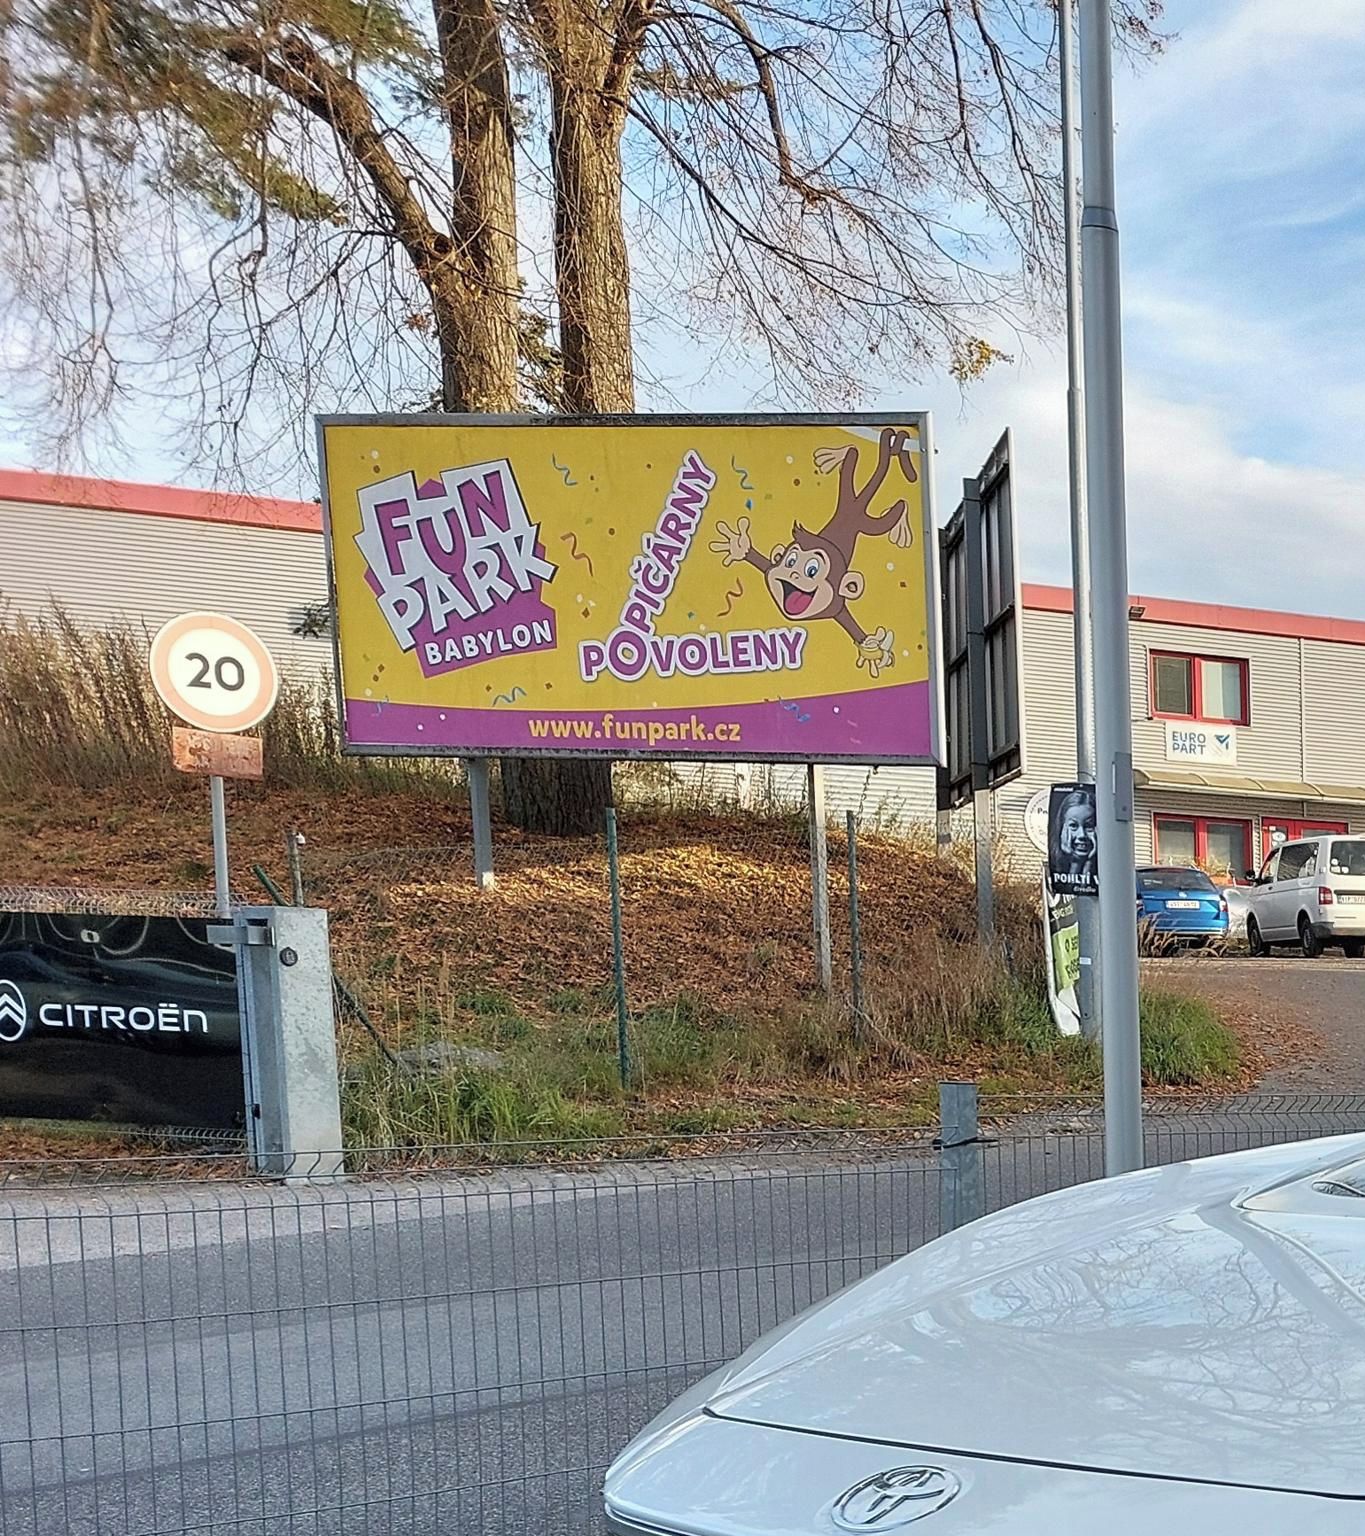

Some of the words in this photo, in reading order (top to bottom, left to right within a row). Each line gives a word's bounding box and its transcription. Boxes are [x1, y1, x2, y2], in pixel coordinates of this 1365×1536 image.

[374, 470, 511, 576] FUN
[376, 520, 558, 652] PARK
[425, 618, 554, 665] BABYLON
[581, 628, 806, 680] POVOLENY
[184, 652, 245, 692] 20
[528, 715, 742, 745] www.funpark.cz
[1172, 731, 1206, 744] EURO
[1172, 743, 1206, 755] PART
[38, 1002, 209, 1034] CITROËN
